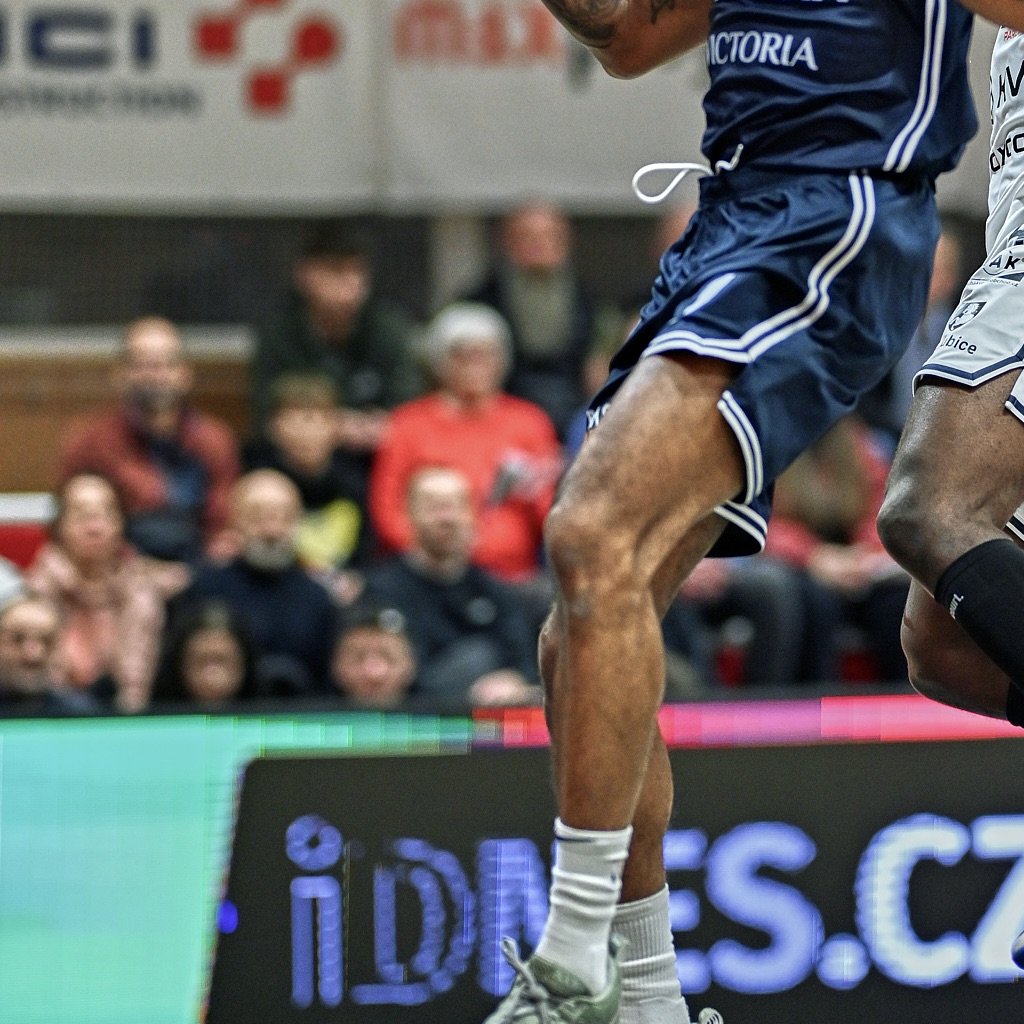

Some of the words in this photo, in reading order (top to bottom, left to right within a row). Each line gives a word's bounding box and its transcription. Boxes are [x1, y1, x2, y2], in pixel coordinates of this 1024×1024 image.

[0, 5, 157, 71] CI
[706, 30, 819, 71] ICTORIA
[987, 254, 1021, 270] AK
